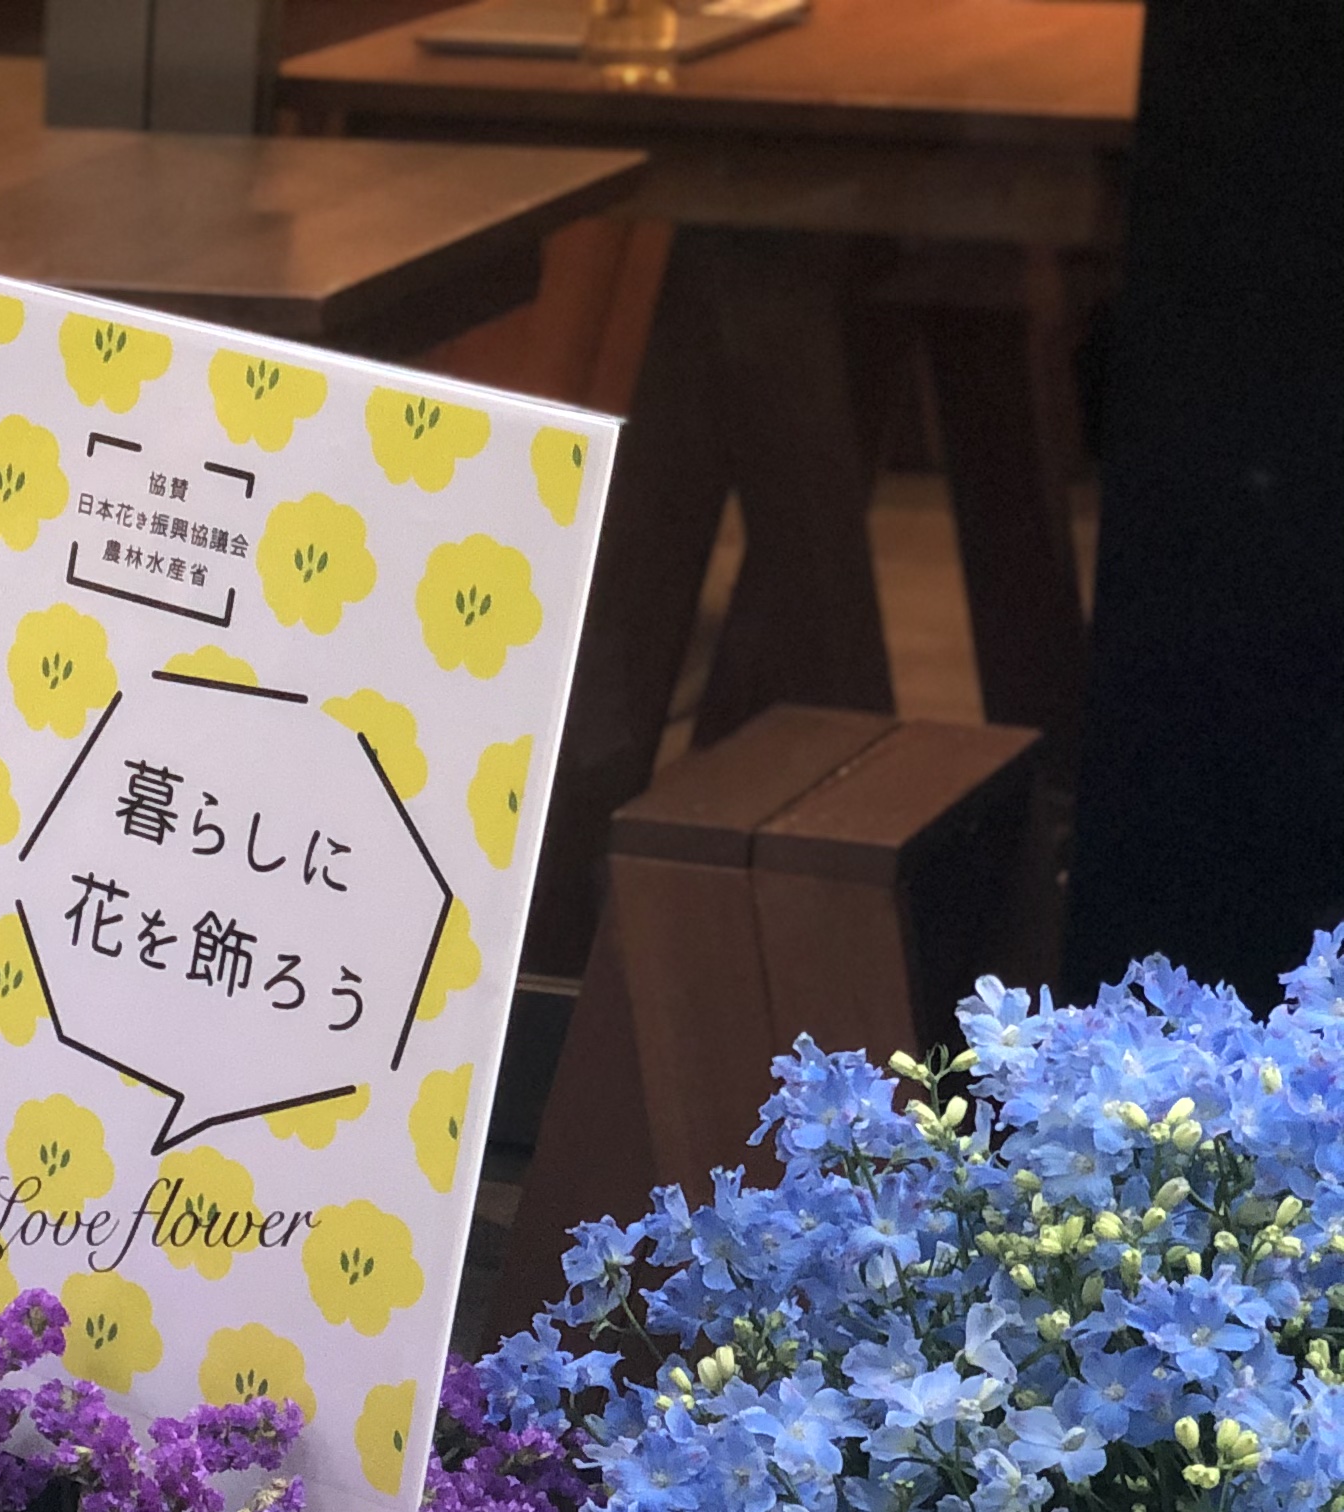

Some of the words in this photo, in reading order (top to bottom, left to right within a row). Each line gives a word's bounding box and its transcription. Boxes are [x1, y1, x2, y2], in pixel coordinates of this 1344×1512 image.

[78, 493, 249, 558] 日本花き振興協議会
[149, 471, 188, 502] 協賛
[102, 539, 208, 588] 農林水産省
[115, 760, 351, 892] 暮らしに
[65, 873, 362, 1031] 花を飾ろう
[87, 1177, 322, 1273] flower
